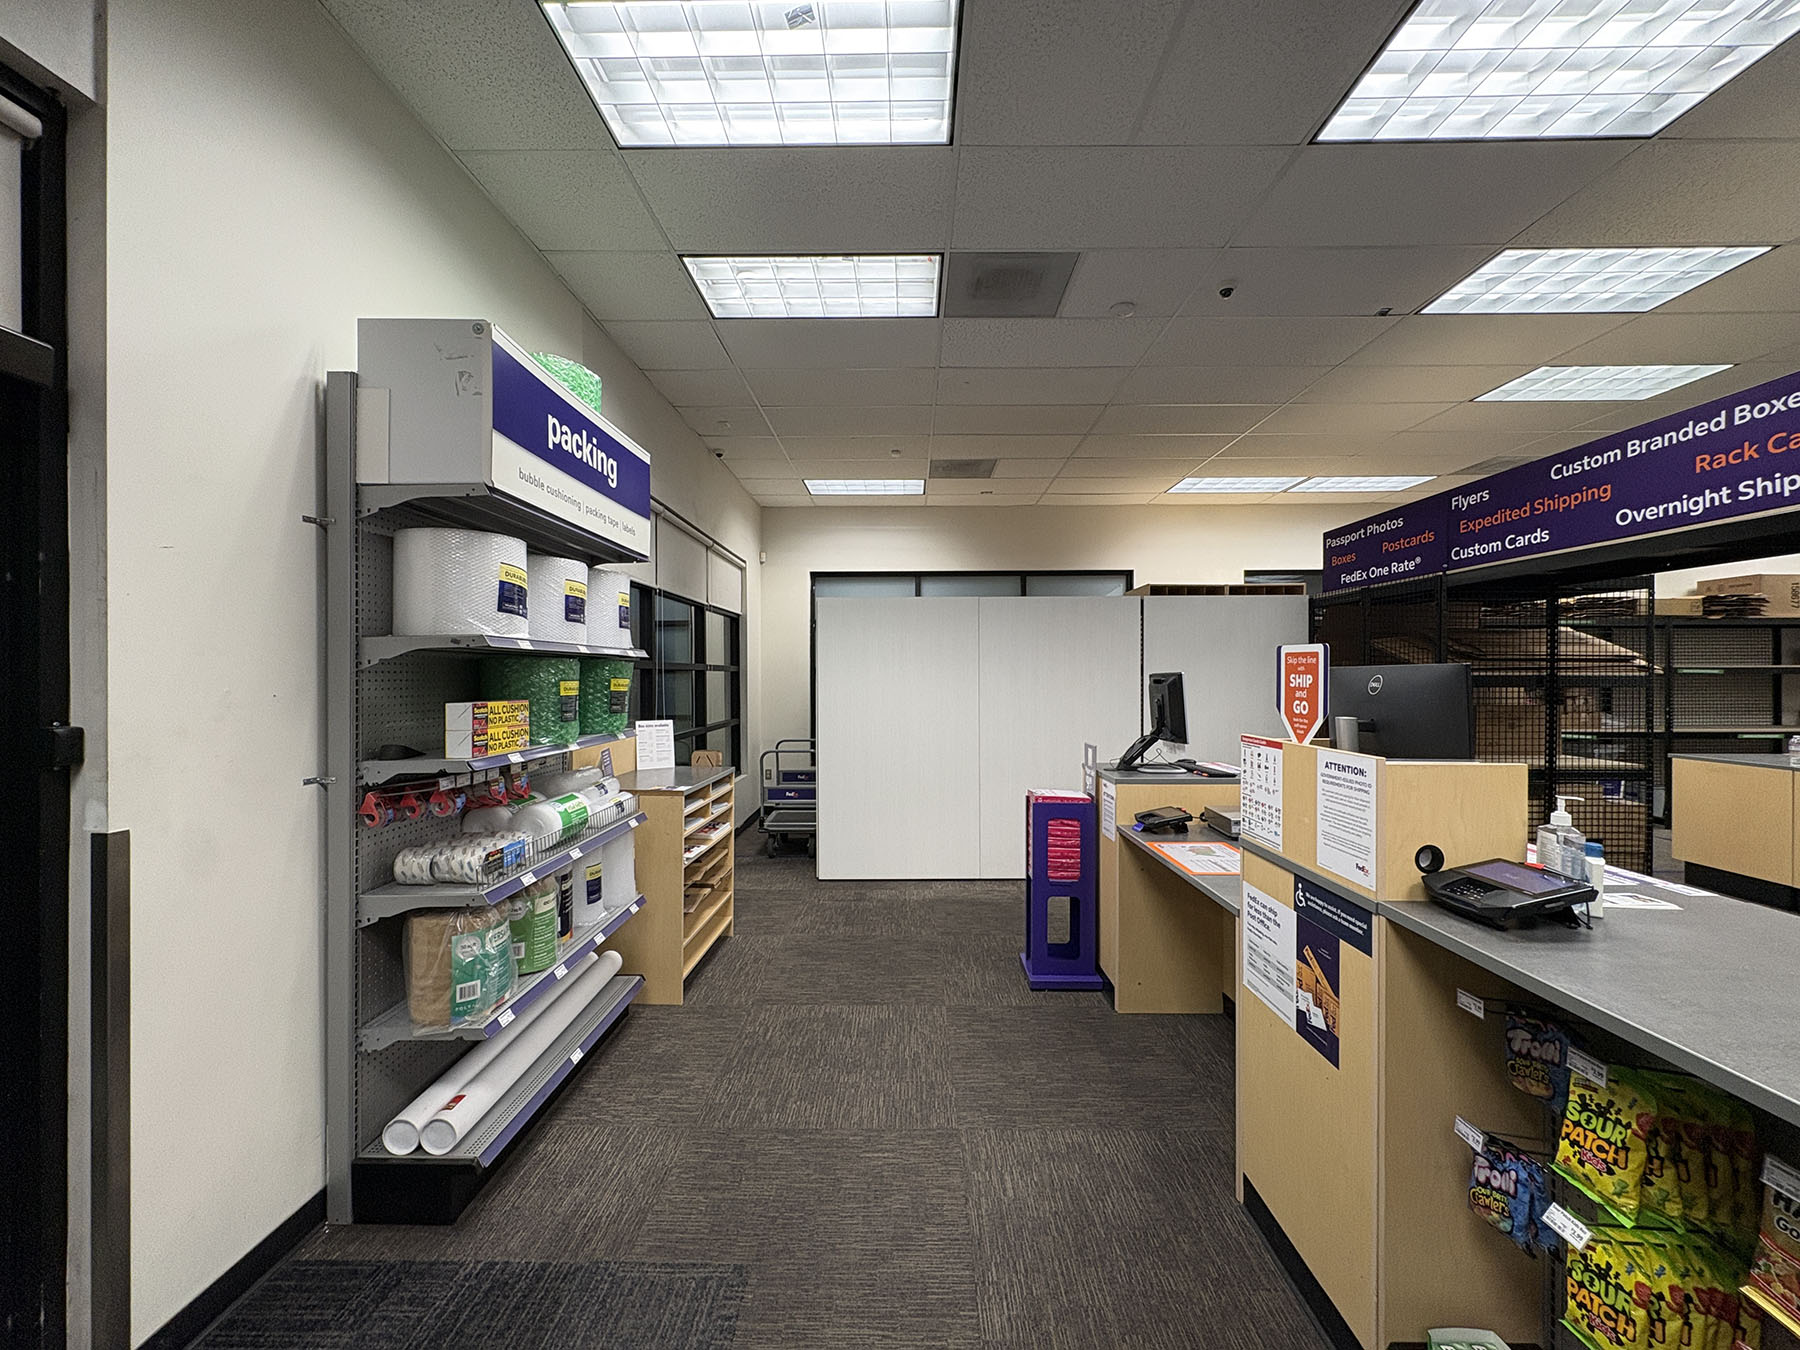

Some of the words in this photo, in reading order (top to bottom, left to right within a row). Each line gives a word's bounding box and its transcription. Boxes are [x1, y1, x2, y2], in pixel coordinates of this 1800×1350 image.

[547, 413, 618, 489] packing
[1550, 447, 1622, 480] Custom
[1626, 410, 1727, 458] Branded
[1695, 441, 1760, 474] Rack
[518, 466, 545, 491] bubble
[546, 484, 582, 512] cushioning
[585, 505, 608, 525] packing
[607, 516, 619, 529] tape
[621, 521, 636, 536] labels
[1451, 490, 1490, 511] Flyers
[1459, 501, 1531, 534] Expedited
[1533, 484, 1612, 515] Shipping
[1615, 486, 1732, 527] Overnight
[1737, 472, 1800, 501] Ship
[1325, 527, 1366, 549] Passport
[1366, 517, 1404, 537] Photos
[1382, 530, 1436, 553] Postcards
[1450, 540, 1502, 561] Custom
[1505, 528, 1550, 550] Cards
[1331, 552, 1357, 567] Boxes
[1340, 569, 1368, 585] FedEx
[1368, 565, 1389, 579] One
[1286, 655, 1297, 665] Skip
[1297, 656, 1306, 664] the
[1307, 655, 1317, 664] line
[1289, 673, 1313, 688] SHIP
[1295, 689, 1307, 698] and
[489, 716, 498, 725] NO
[498, 714, 519, 724] PLASTIC
[490, 705, 501, 715] ALL
[501, 703, 529, 714] CUSHION
[1292, 699, 1309, 715] GO
[488, 742, 498, 752] NO
[498, 739, 519, 750] PLASTIC
[490, 731, 501, 742] ALL
[501, 728, 529, 741] CUSHION
[1324, 760, 1368, 778] ATTENTION:
[1247, 892, 1260, 906] FedEx
[1260, 901, 1268, 911] can
[1506, 1027, 1561, 1064] Trolli
[1506, 1060, 1550, 1085] Crawlers
[1566, 1101, 1628, 1148] SOUR
[1561, 1118, 1629, 1170] PATCH
[1580, 1147, 1608, 1173] Kids
[1473, 1154, 1518, 1197] Trolli
[1469, 1187, 1511, 1217] Crawlers
[1775, 1216, 1800, 1242] Go
[1570, 1260, 1632, 1320] SOUR
[1567, 1276, 1636, 1342] PATCH
